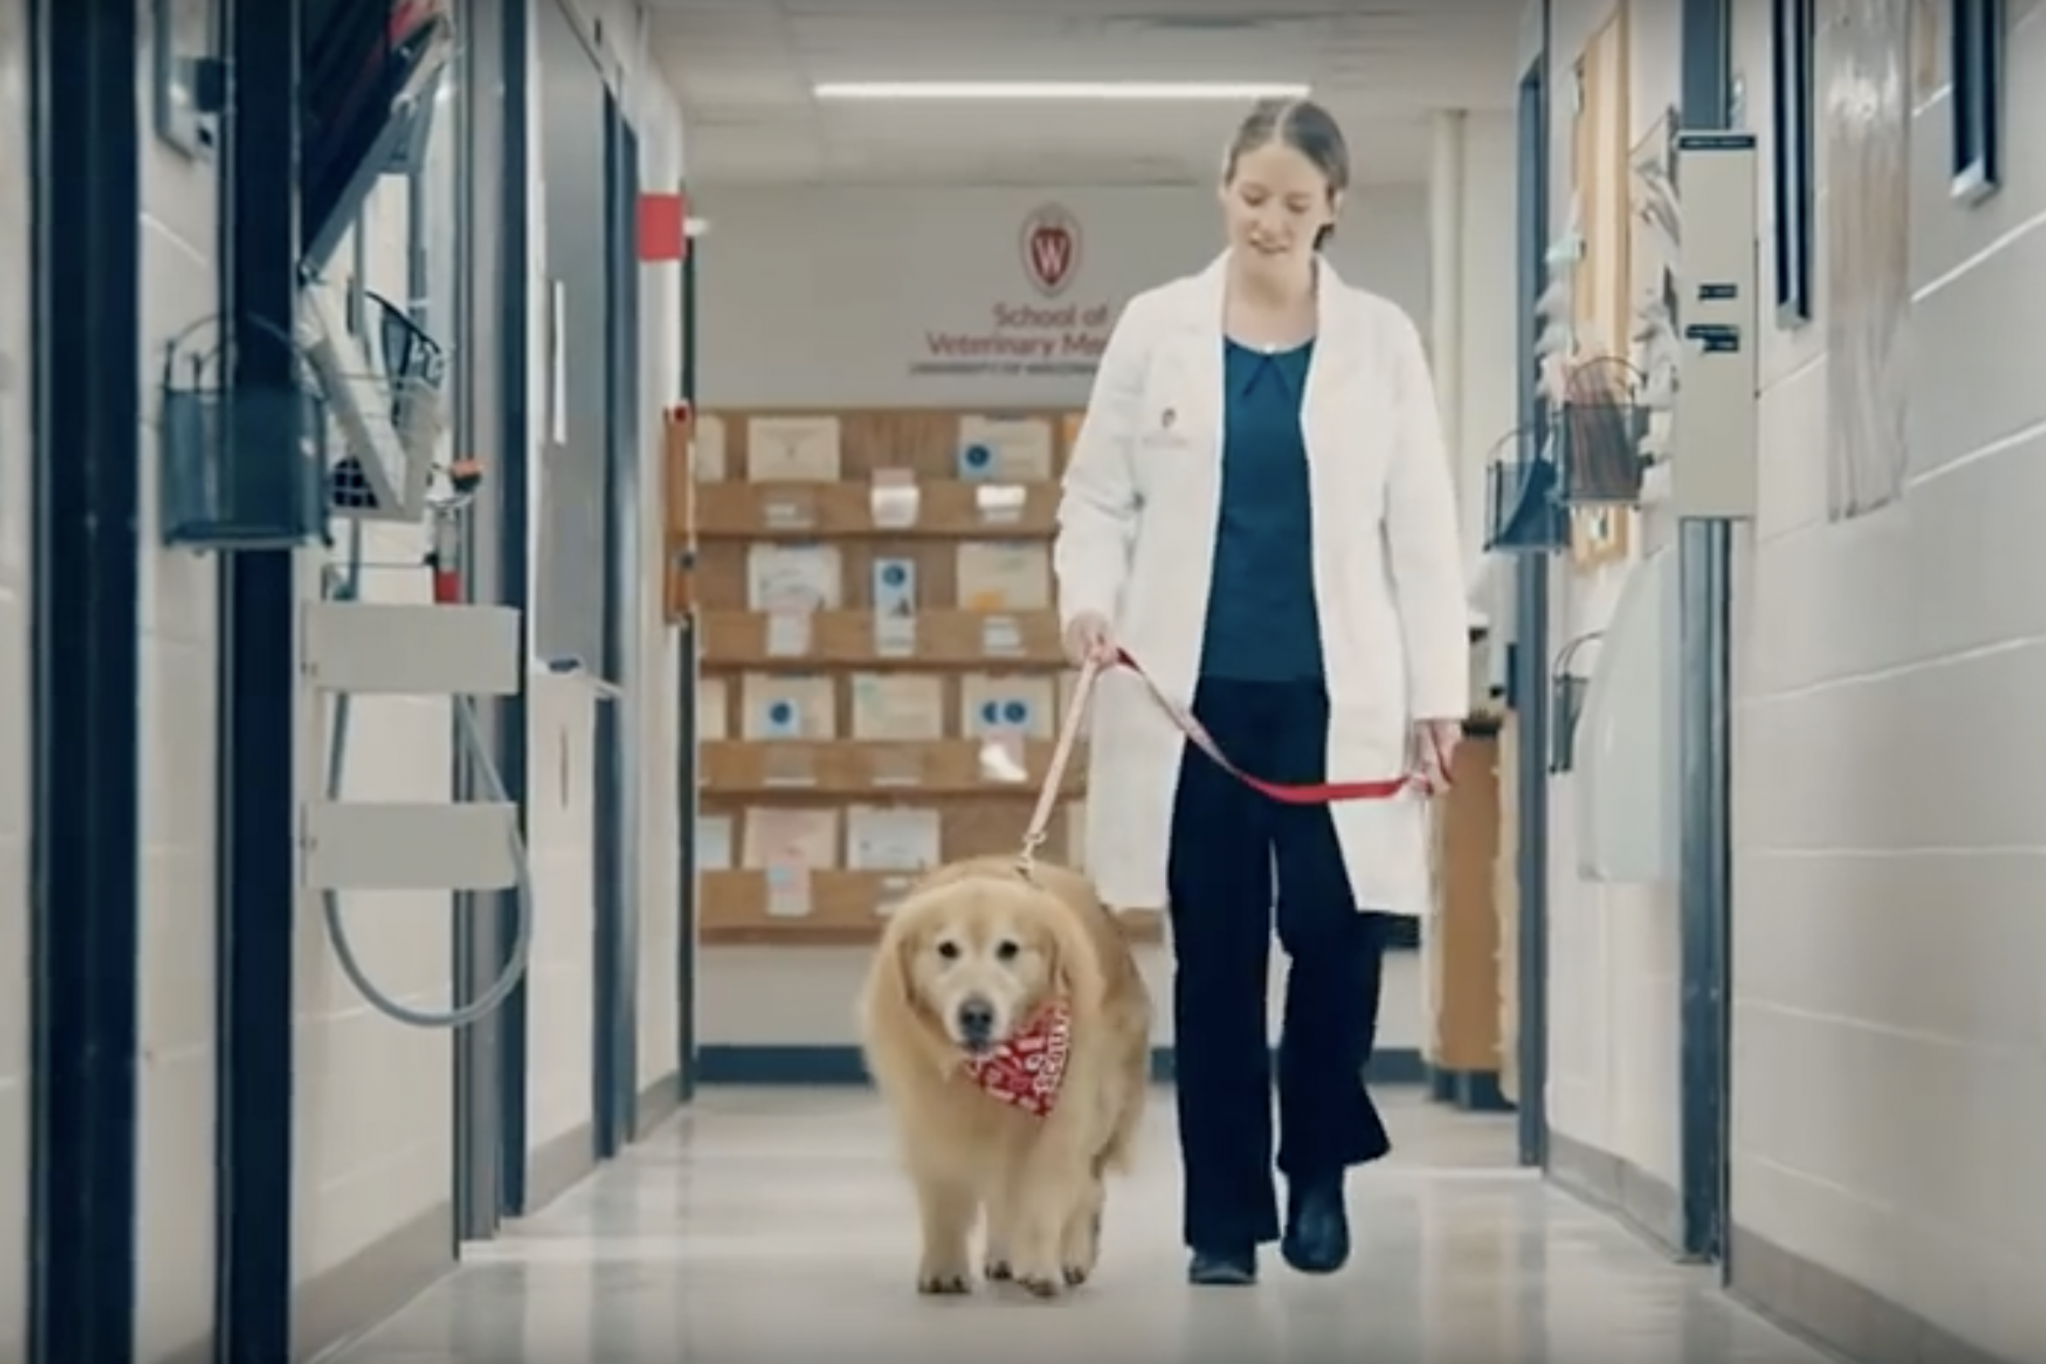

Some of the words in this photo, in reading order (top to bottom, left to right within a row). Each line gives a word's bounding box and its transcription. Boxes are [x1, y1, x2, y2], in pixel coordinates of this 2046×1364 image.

[1034, 234, 1068, 277] W
[992, 303, 1076, 327] School
[926, 331, 1055, 357] Veterinary
